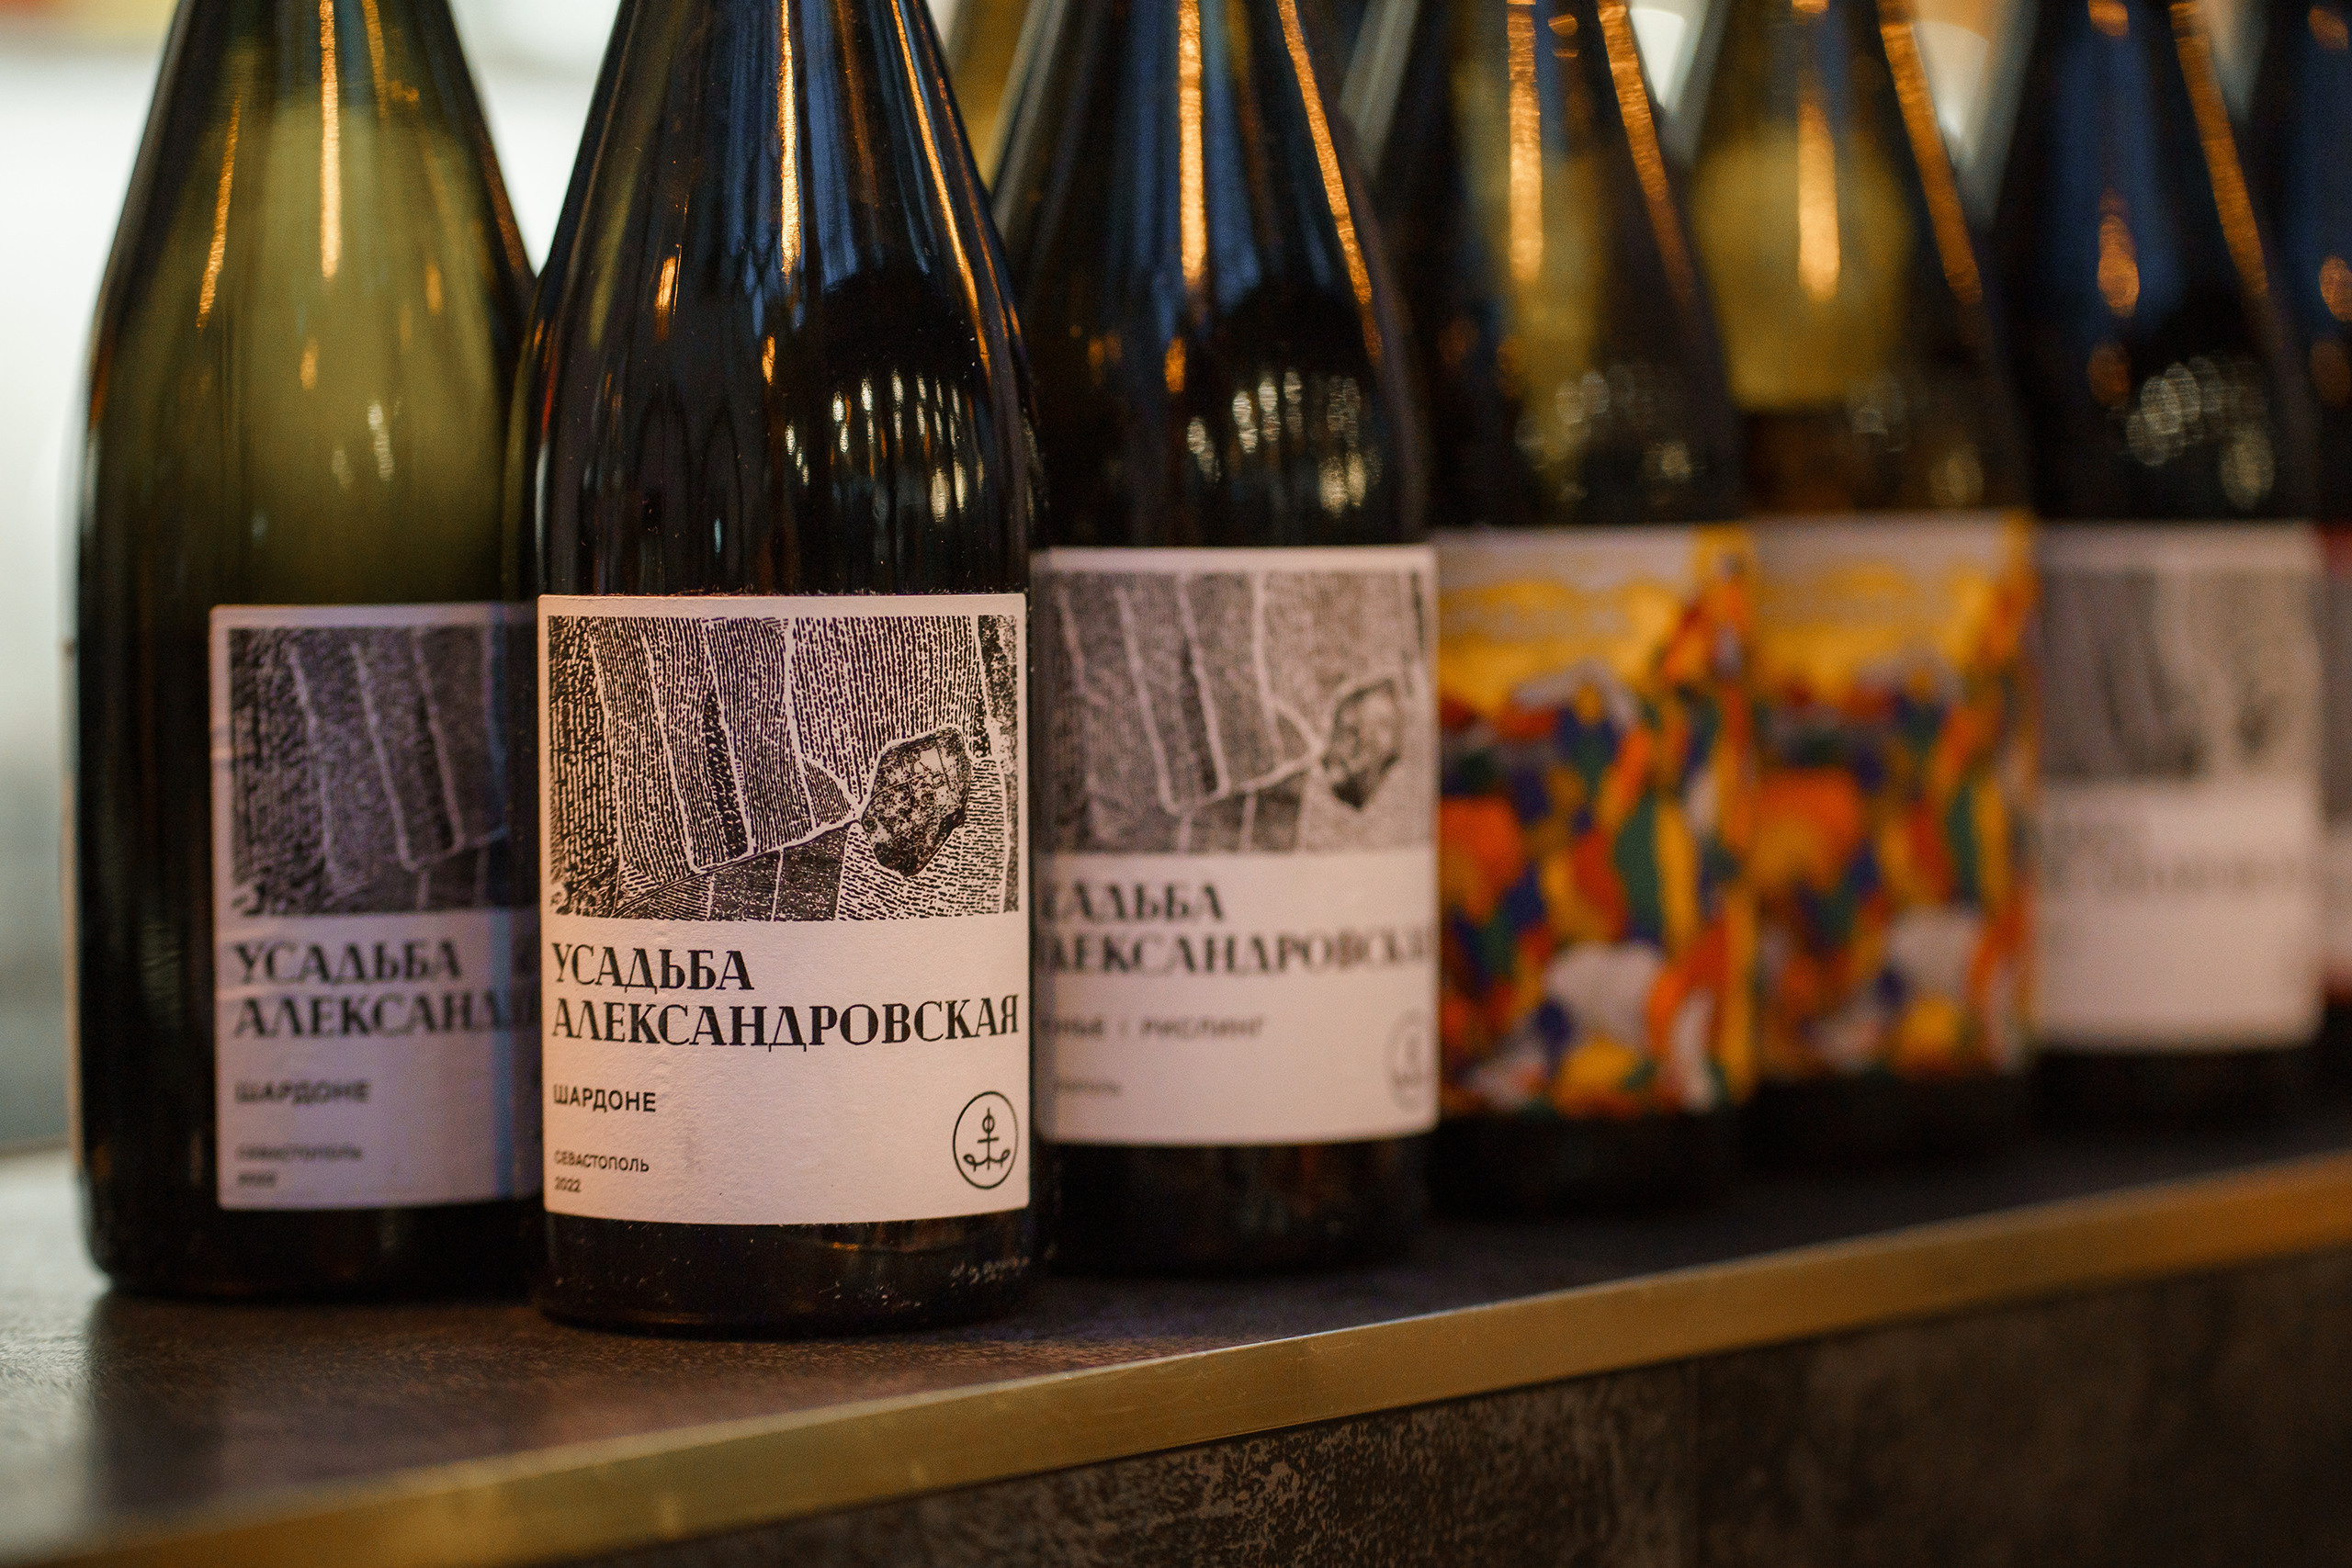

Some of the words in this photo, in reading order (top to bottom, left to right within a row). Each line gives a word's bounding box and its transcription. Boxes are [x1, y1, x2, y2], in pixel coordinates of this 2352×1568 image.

[232, 936, 462, 986] УСАДЬБА
[551, 942, 755, 995] УСАДЬБА
[551, 994, 1020, 1053] АЛЕКСАНДРОВСКАЯ
[234, 1079, 369, 1105] ШАРДОНЕ
[553, 1083, 656, 1113] ШАРДОНЕ
[554, 1149, 650, 1172] СЕВАСТОПОЛЬ
[554, 1176, 582, 1193] 2022
